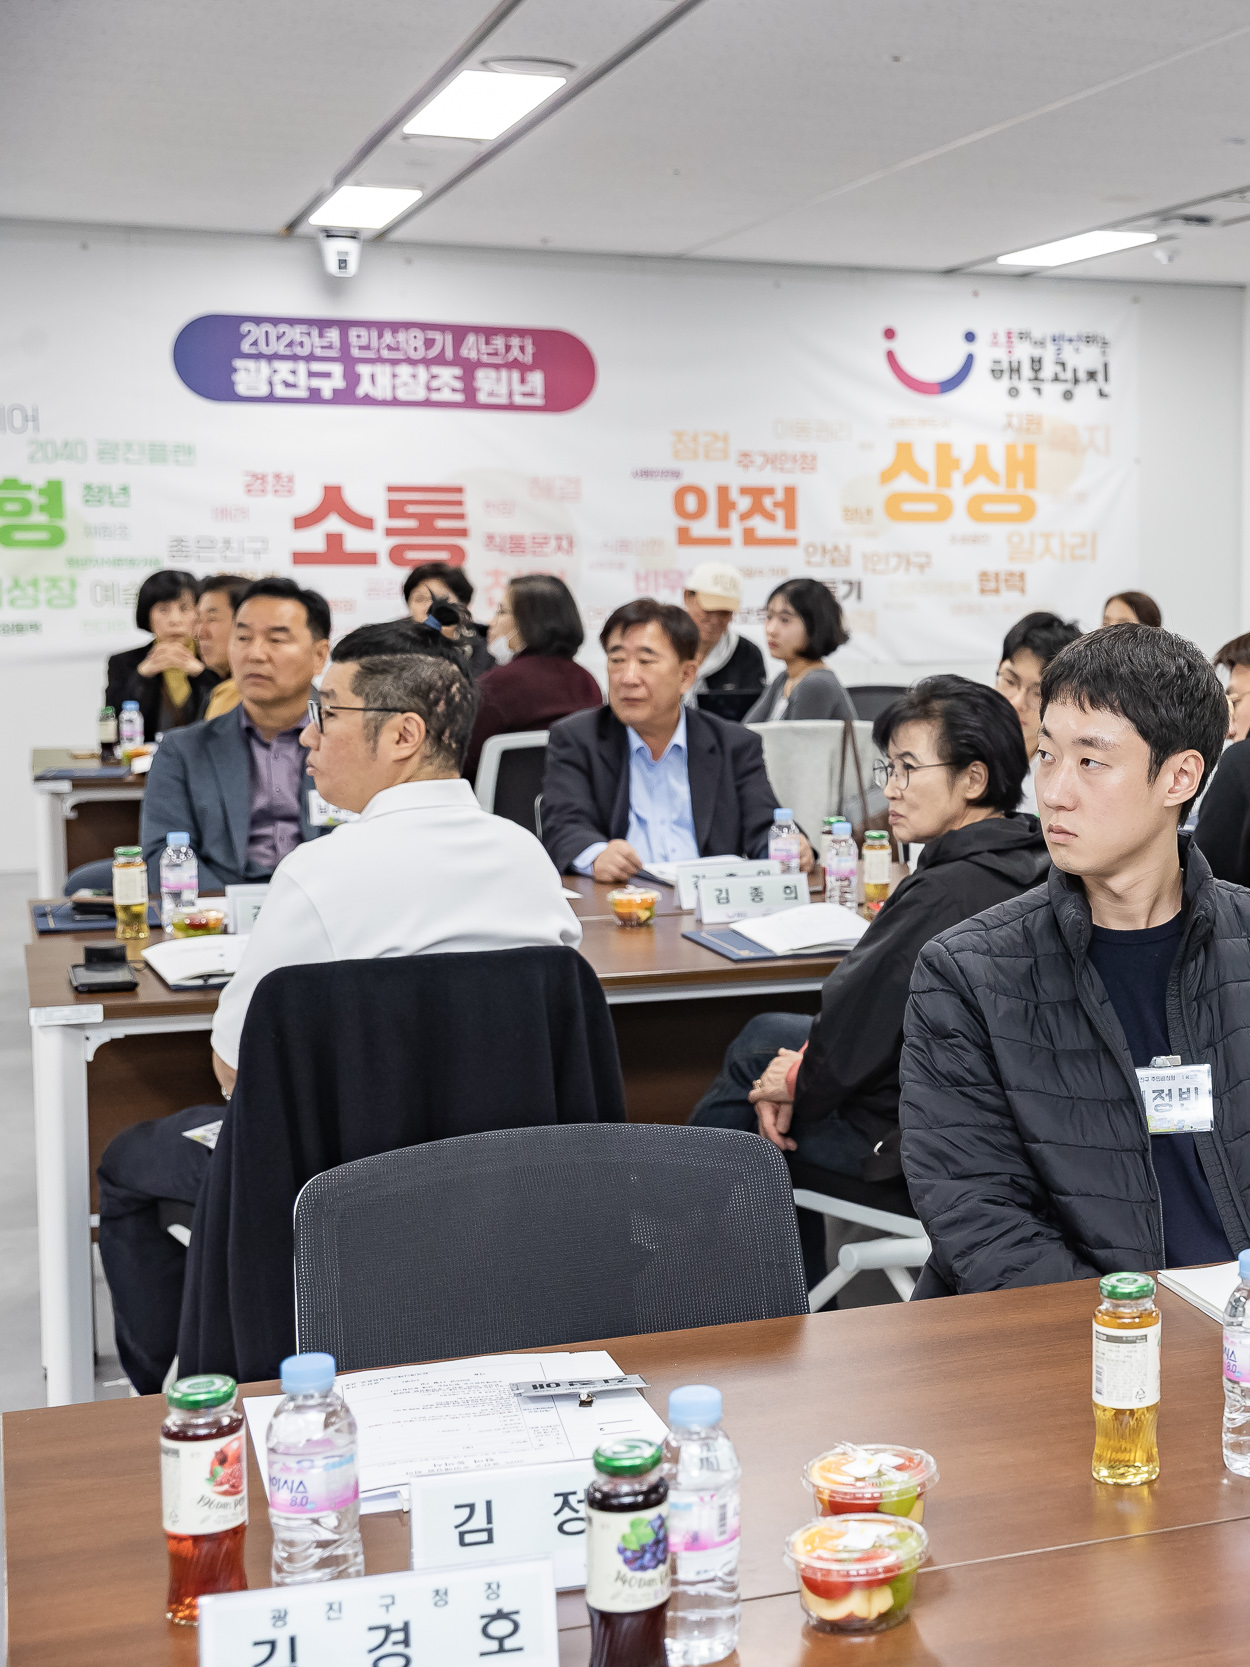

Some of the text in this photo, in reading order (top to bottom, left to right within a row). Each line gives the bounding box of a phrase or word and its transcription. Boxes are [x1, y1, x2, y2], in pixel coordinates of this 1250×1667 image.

[240, 322, 537, 365] 2025년 민선8기 4년차
[231, 358, 547, 407] 광진구 재창조 원년
[990, 357, 1109, 399] 행복광진
[27, 439, 88, 464] 2040
[671, 430, 730, 461] 점검
[879, 441, 1038, 523] 상생
[291, 484, 470, 568] 소통
[673, 484, 798, 547] 안전
[804, 542, 851, 568] 안심
[1006, 530, 1098, 563] 일자리
[0, 576, 77, 609] 성장
[978, 570, 1027, 596] 협력
